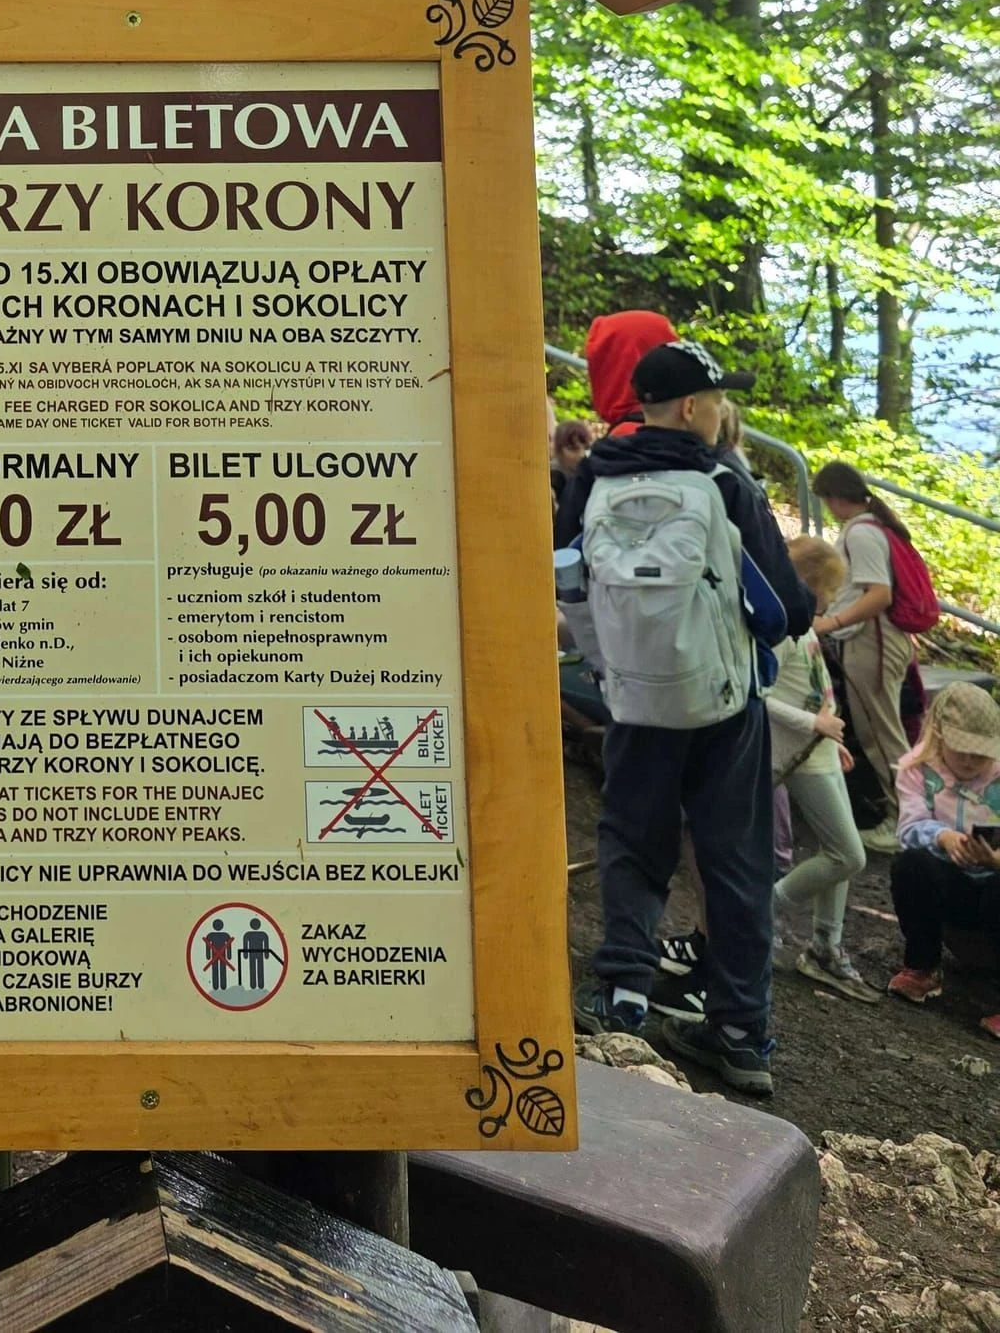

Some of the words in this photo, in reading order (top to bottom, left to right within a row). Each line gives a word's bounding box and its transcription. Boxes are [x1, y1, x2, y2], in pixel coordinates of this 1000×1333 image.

[63, 103, 408, 149] BILETOWA
[127, 181, 415, 231] KORONY
[22, 262, 86, 284] 15.XI
[98, 261, 300, 289] OBOWIĄZUJĄ
[309, 261, 427, 283] OPŁATY
[54, 295, 224, 317] KORONACH
[237, 295, 241, 317] I
[253, 294, 407, 317] SOKOLICY
[49, 329, 67, 343] W
[73, 329, 112, 343] TYM
[120, 329, 189, 343] SAMYM
[197, 328, 242, 343] DNIU
[250, 328, 277, 342] NA
[283, 328, 325, 342] OBA
[331, 328, 421, 343] SZCZYTY.
[5, 401, 32, 413] FEE
[37, 400, 109, 412] CHARGED
[116, 400, 145, 412] FOR
[150, 400, 226, 412] SOKOLICA
[229, 400, 260, 411] AND
[265, 401, 302, 413] TRZY
[307, 400, 372, 411] KORONY.
[170, 453, 261, 477] BILET
[273, 453, 418, 478] ULGOWY
[57, 505, 121, 545] ZŁ
[198, 493, 325, 556] 5,00
[351, 504, 416, 545] ZŁ
[168, 562, 253, 579] przysługuje
[259, 566, 276, 578] (po
[280, 566, 327, 575] okazaniu
[332, 566, 378, 578] ważnego
[382, 566, 450, 576] dokumentu):
[42, 572, 68, 593] się
[76, 571, 106, 588] od:
[0, 599, 16, 611] lat
[22, 601, 29, 611] 7
[178, 590, 242, 603] uczniom
[248, 590, 286, 602] szkół
[292, 590, 295, 602] i
[301, 590, 380, 602] studentom
[178, 612, 254, 626] emerytom
[260, 610, 263, 622] i
[270, 610, 344, 622] rencistom
[180, 670, 278, 687] posiadaczom
[285, 671, 324, 687] Karty
[331, 670, 374, 686] Dużej
[381, 670, 442, 687] Rodziny
[20, 710, 46, 726] ZE
[53, 709, 139, 726] SPŁYWU
[148, 709, 262, 725] DUNAJCEM
[417, 716, 429, 757] BILET
[433, 713, 445, 763] TICKET
[24, 786, 96, 801] TICKETS
[103, 786, 137, 800] FOR
[143, 786, 176, 800] THE
[183, 786, 264, 800] DUNAJEC
[420, 791, 431, 833] BILET
[436, 786, 448, 836] TICKET
[40, 865, 71, 881] NIE
[79, 865, 187, 881] UPRAWNIA
[193, 865, 221, 881] DO
[228, 861, 320, 881] WEJŚCIA
[326, 865, 365, 880] BEZ
[372, 864, 459, 881] KOLEJKI
[11, 927, 94, 946] GALERIĘ
[302, 924, 366, 939] ZAKAZ
[302, 947, 447, 962] WYCHODZENIA
[3, 973, 71, 989] CZASIE
[78, 973, 142, 988] BURZY
[303, 970, 328, 985] ZA
[334, 970, 425, 985] BARIERKI
